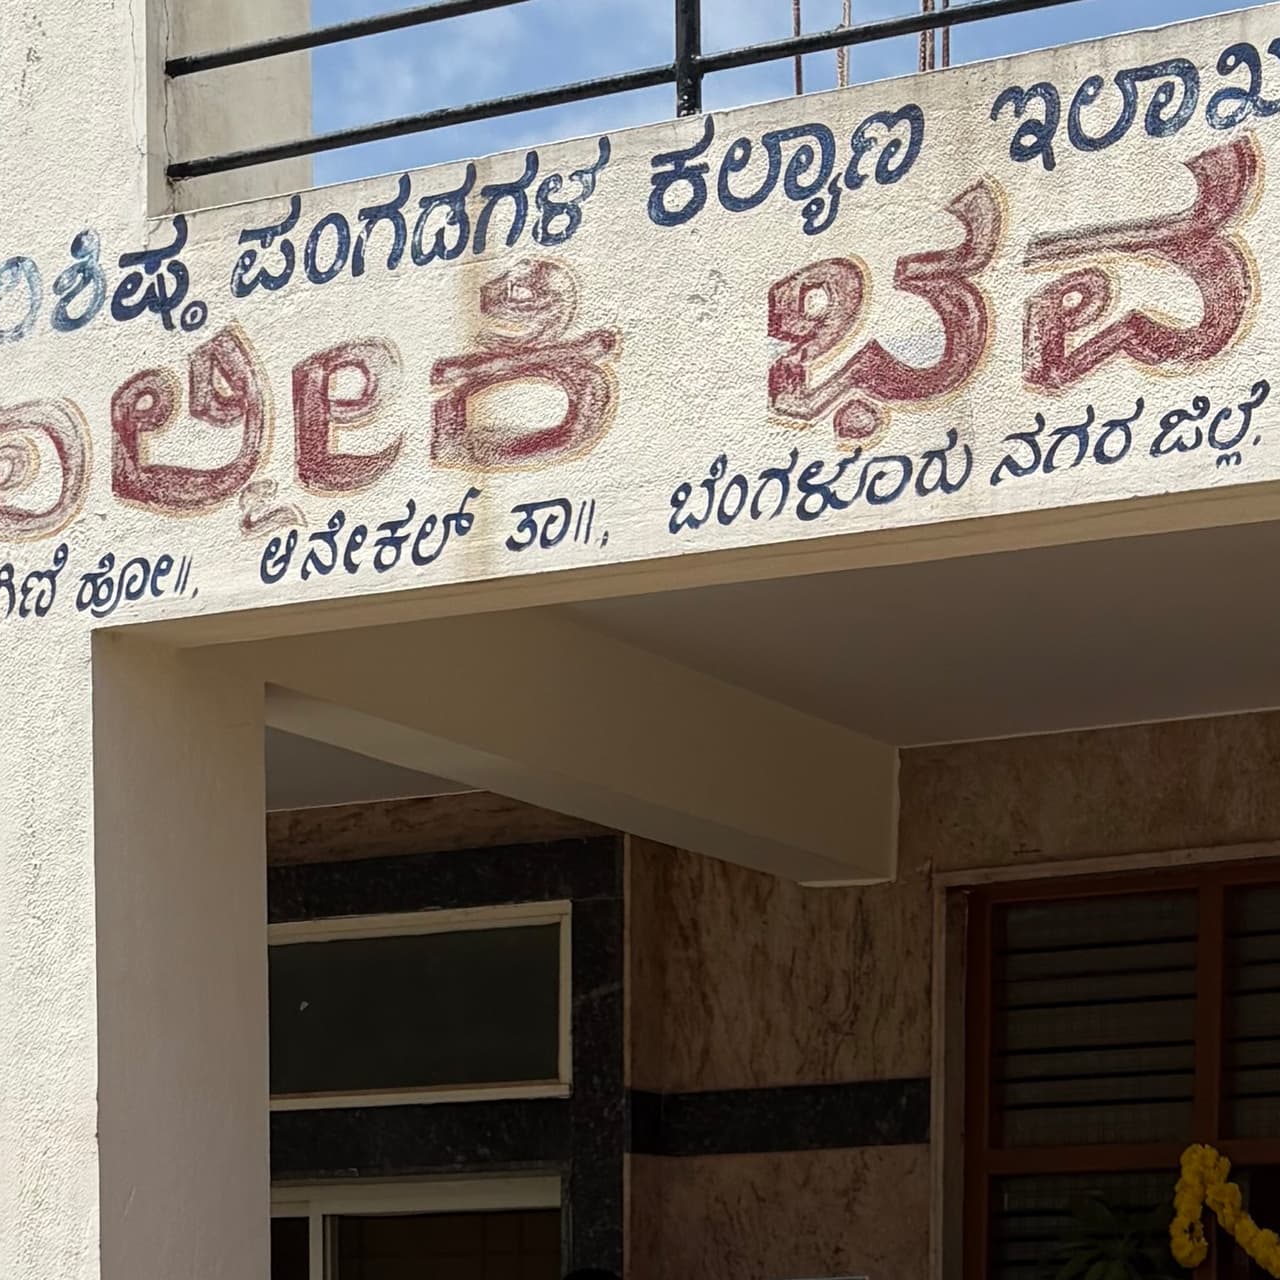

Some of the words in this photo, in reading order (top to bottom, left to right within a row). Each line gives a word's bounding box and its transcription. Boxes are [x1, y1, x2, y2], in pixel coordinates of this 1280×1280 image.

[230, 136, 611, 297] ಪಂಗಡಗಳ
[647, 103, 924, 235] ಕಲ್ಯಾಣ
[261, 487, 482, 583] ಆನೇಕಲ್
[669, 427, 973, 534] ಬೆಂಗಳೂರು
[990, 398, 1144, 486] ನಗರ
